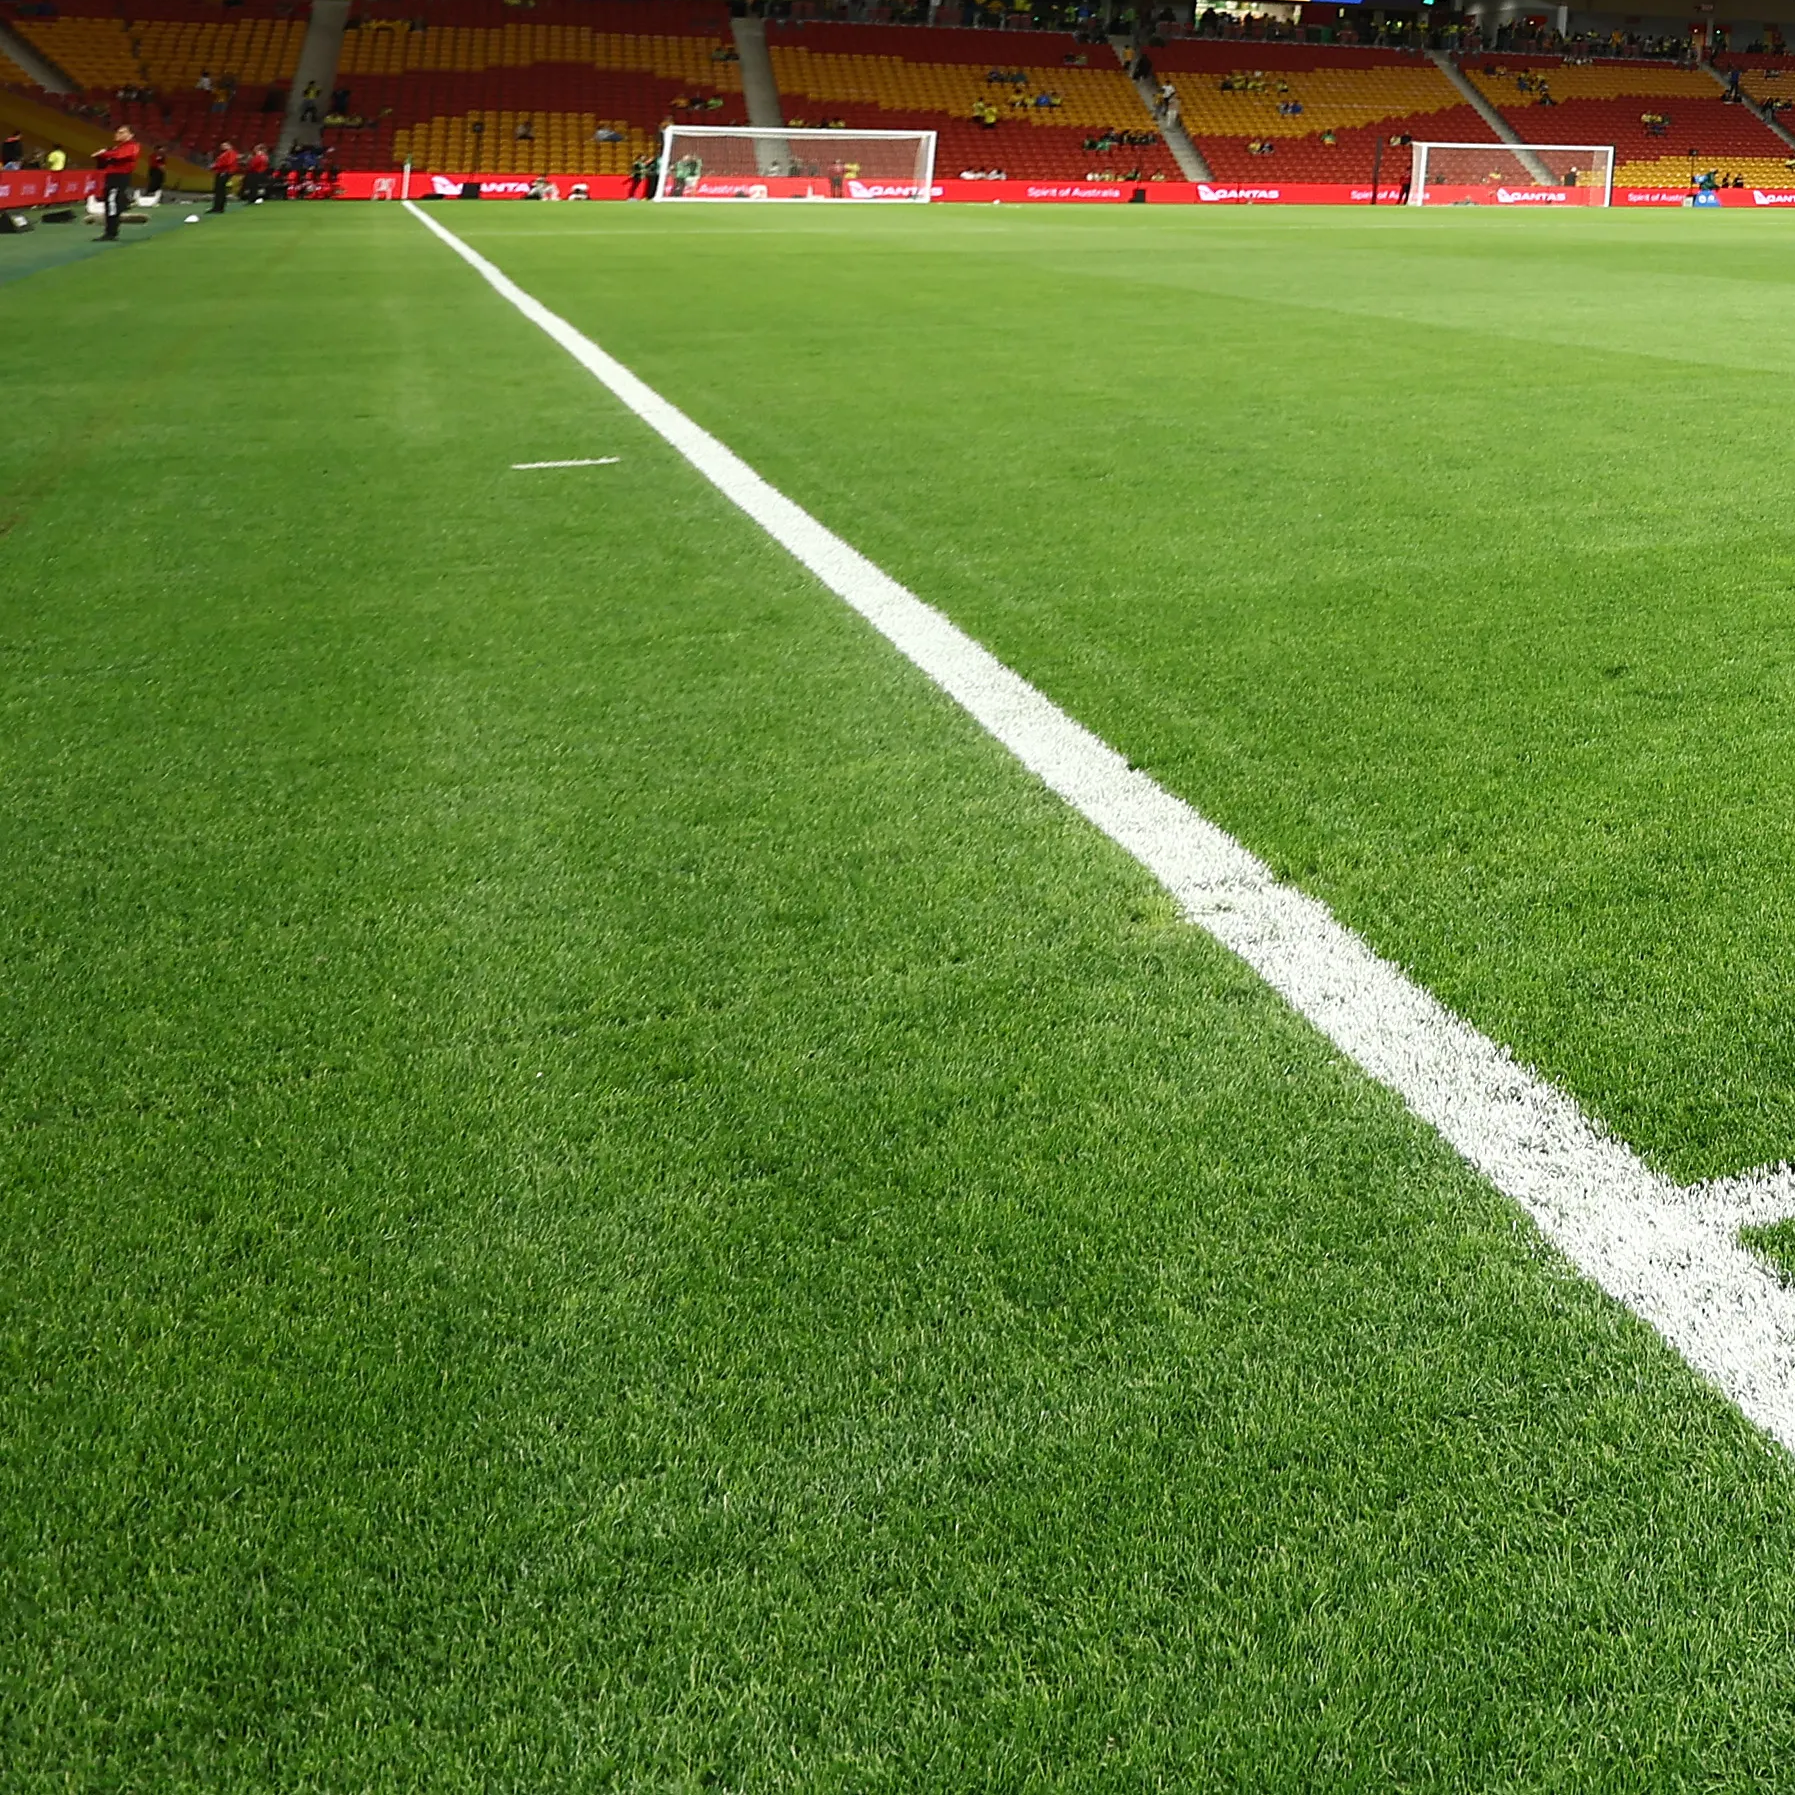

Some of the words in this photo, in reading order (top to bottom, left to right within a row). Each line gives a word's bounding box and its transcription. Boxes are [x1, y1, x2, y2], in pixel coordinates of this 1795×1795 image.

[1027, 187, 1056, 199] Spirit
[1071, 188, 1121, 198] Australia
[1217, 189, 1280, 199] QANTAS
[1512, 192, 1567, 202] QANTAS
